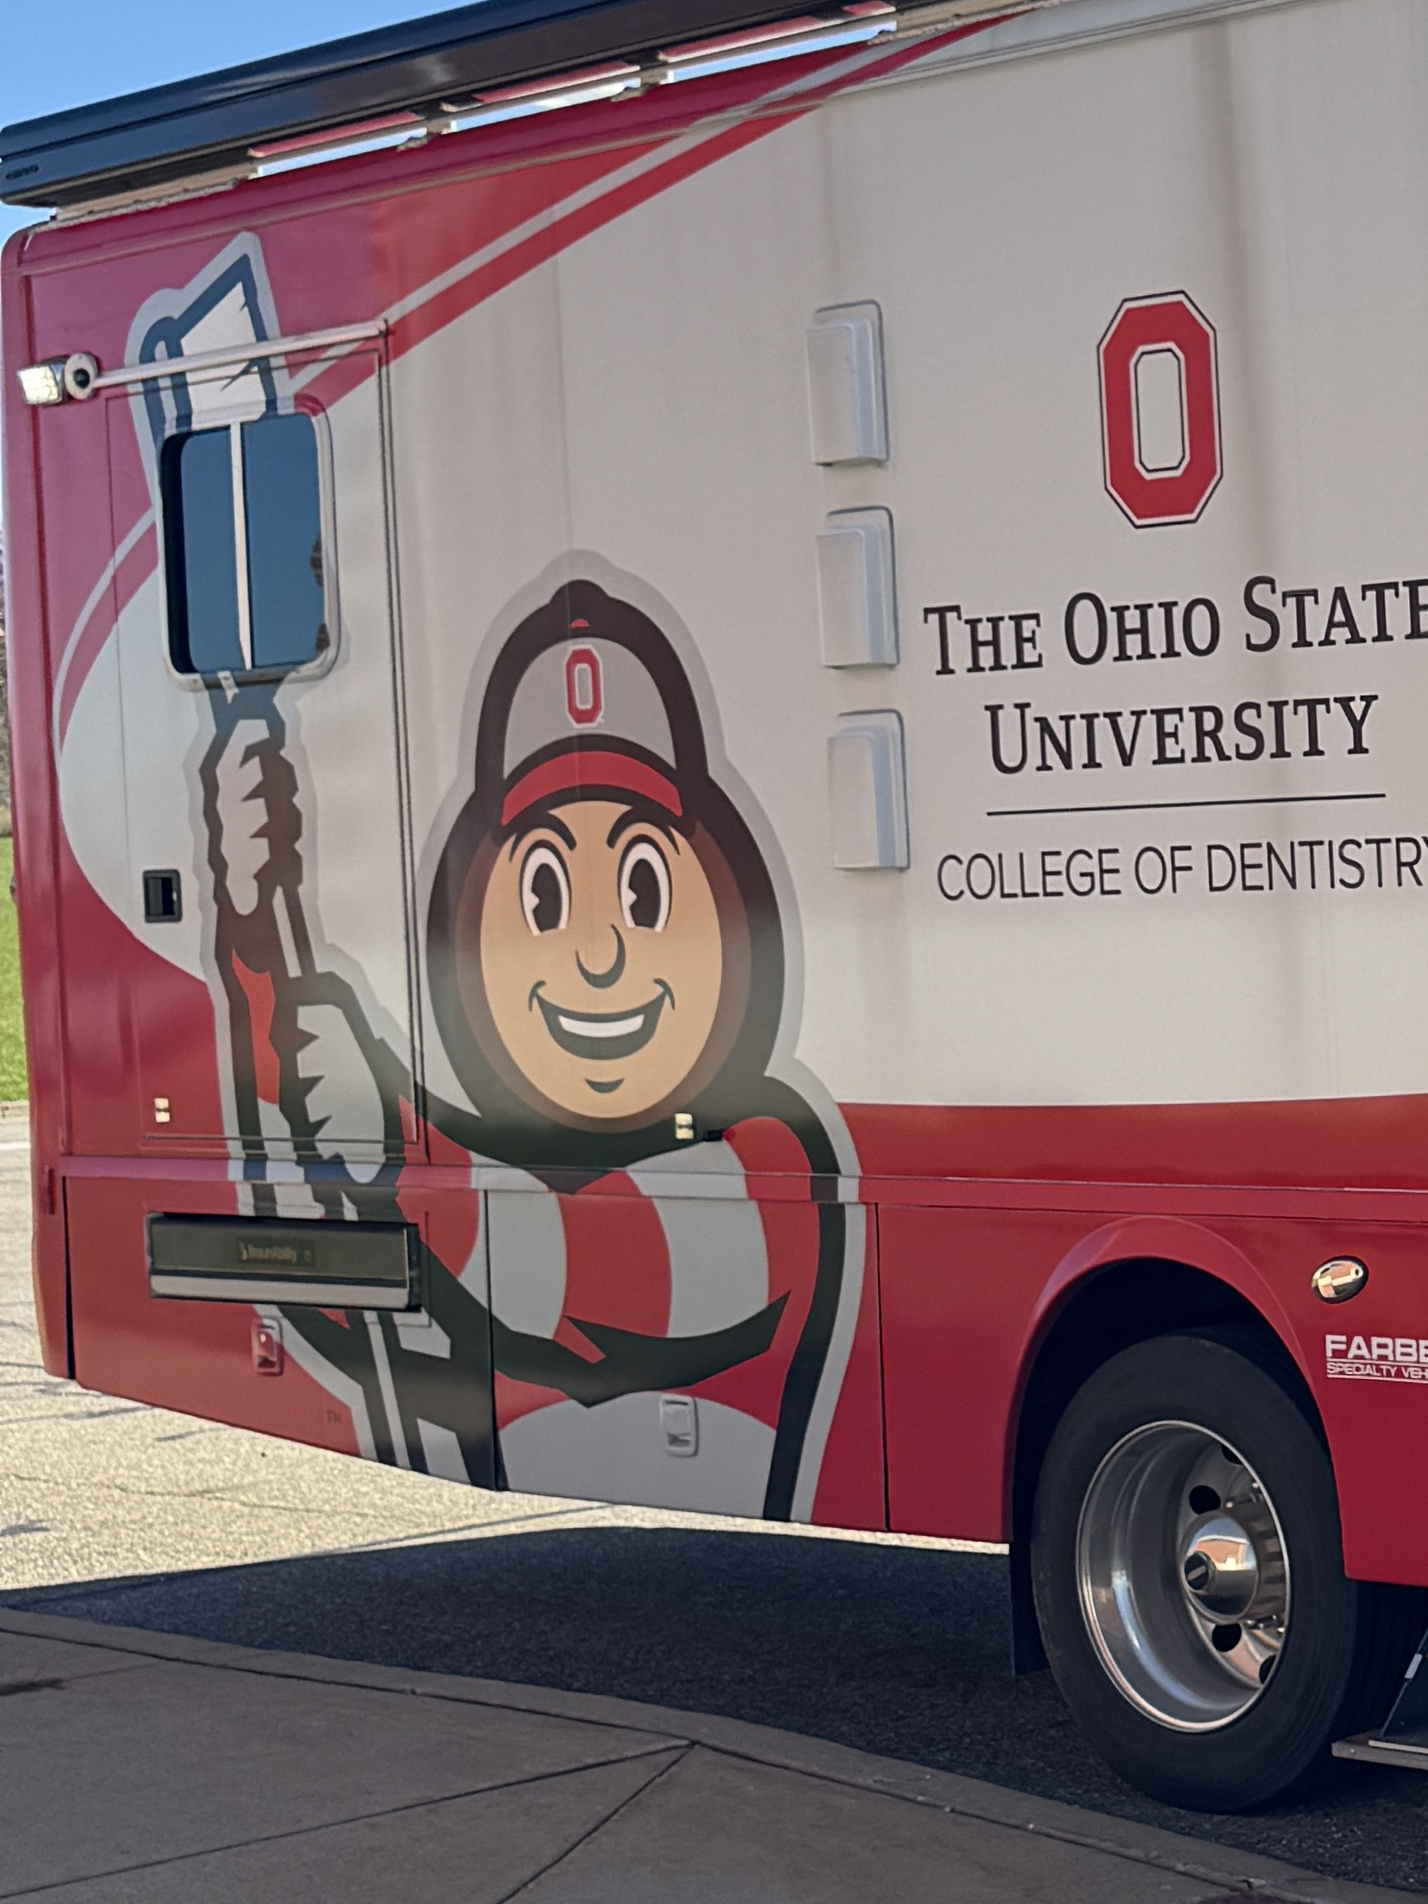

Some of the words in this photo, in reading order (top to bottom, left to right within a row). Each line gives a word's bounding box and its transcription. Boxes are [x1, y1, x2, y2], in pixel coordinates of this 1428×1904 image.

[1096, 289, 1224, 530] O
[564, 644, 605, 729] O
[937, 848, 1122, 901] COLLEGE
[1134, 846, 1193, 895] OF
[1326, 1362, 1398, 1377] SPECIALTY
